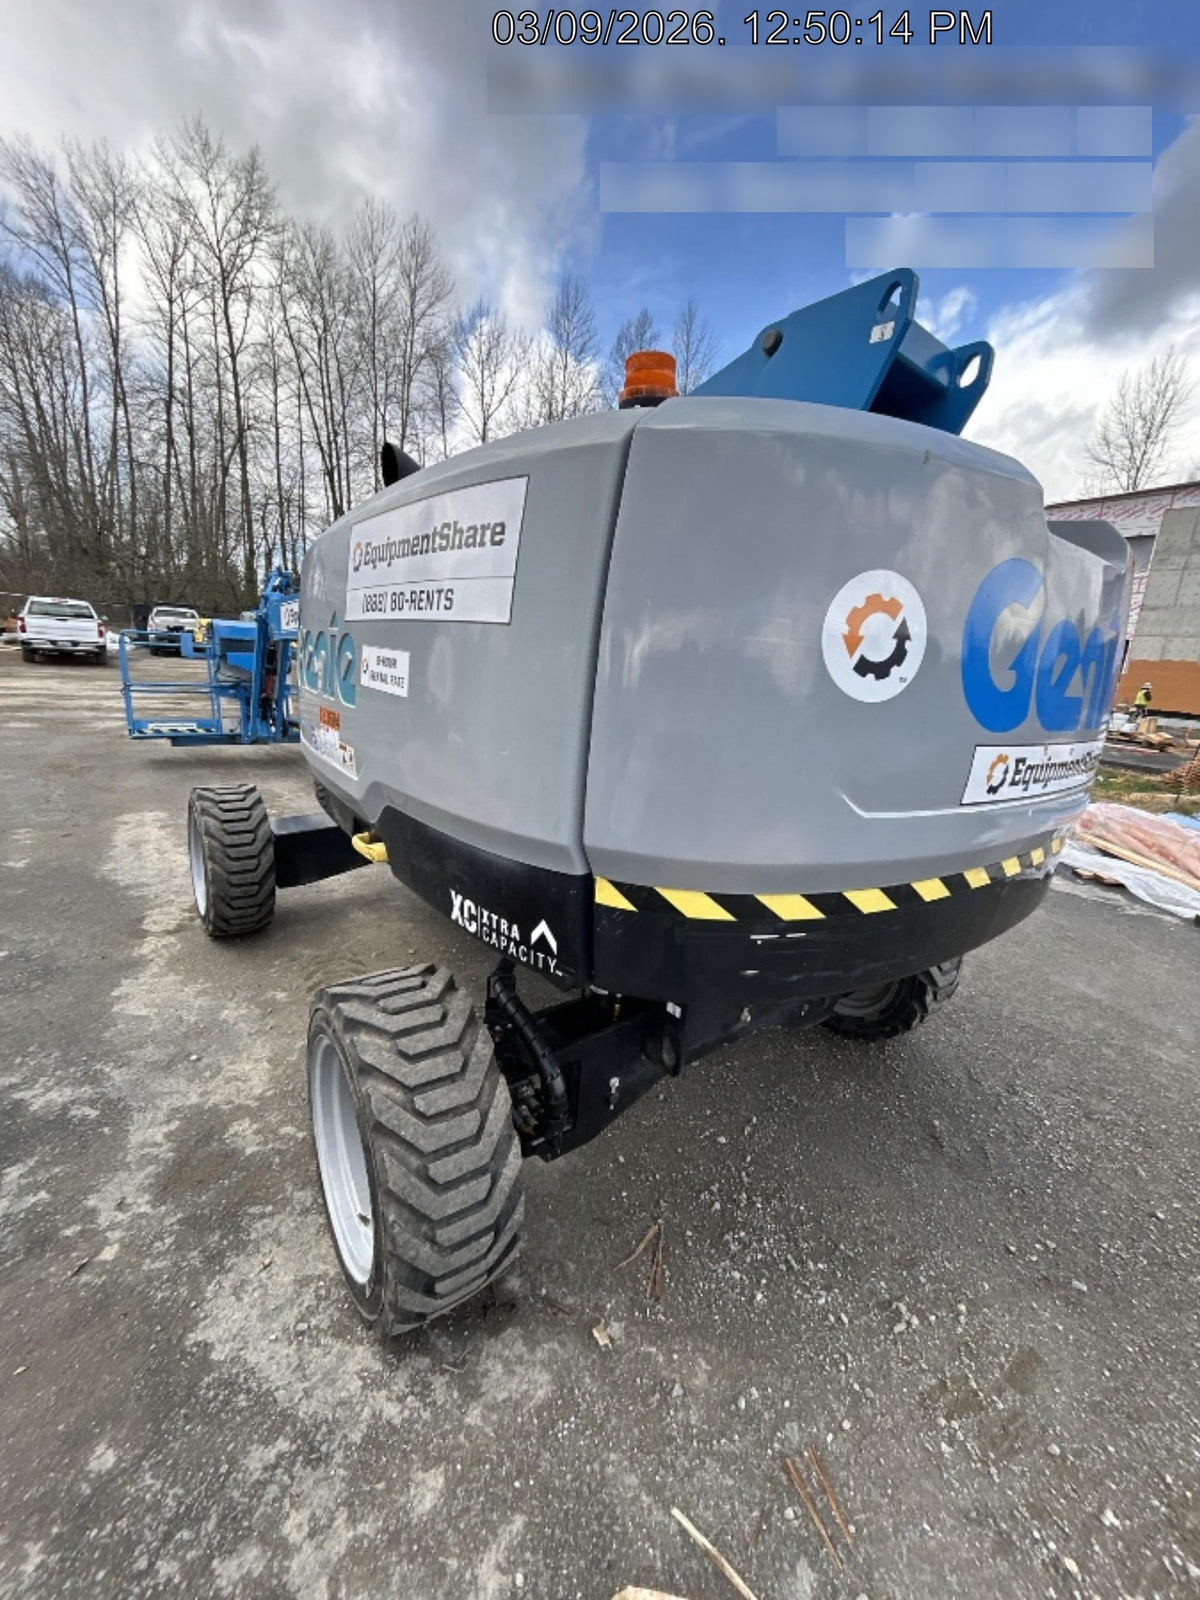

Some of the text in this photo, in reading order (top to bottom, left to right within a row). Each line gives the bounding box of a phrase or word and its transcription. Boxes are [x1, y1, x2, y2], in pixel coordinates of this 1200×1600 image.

[362, 520, 507, 570] EquipmentShare
[961, 557, 1119, 734] Geni
[449, 887, 478, 934] XC
[481, 907, 520, 941] XTRA
[482, 926, 557, 973] CAPACITY
